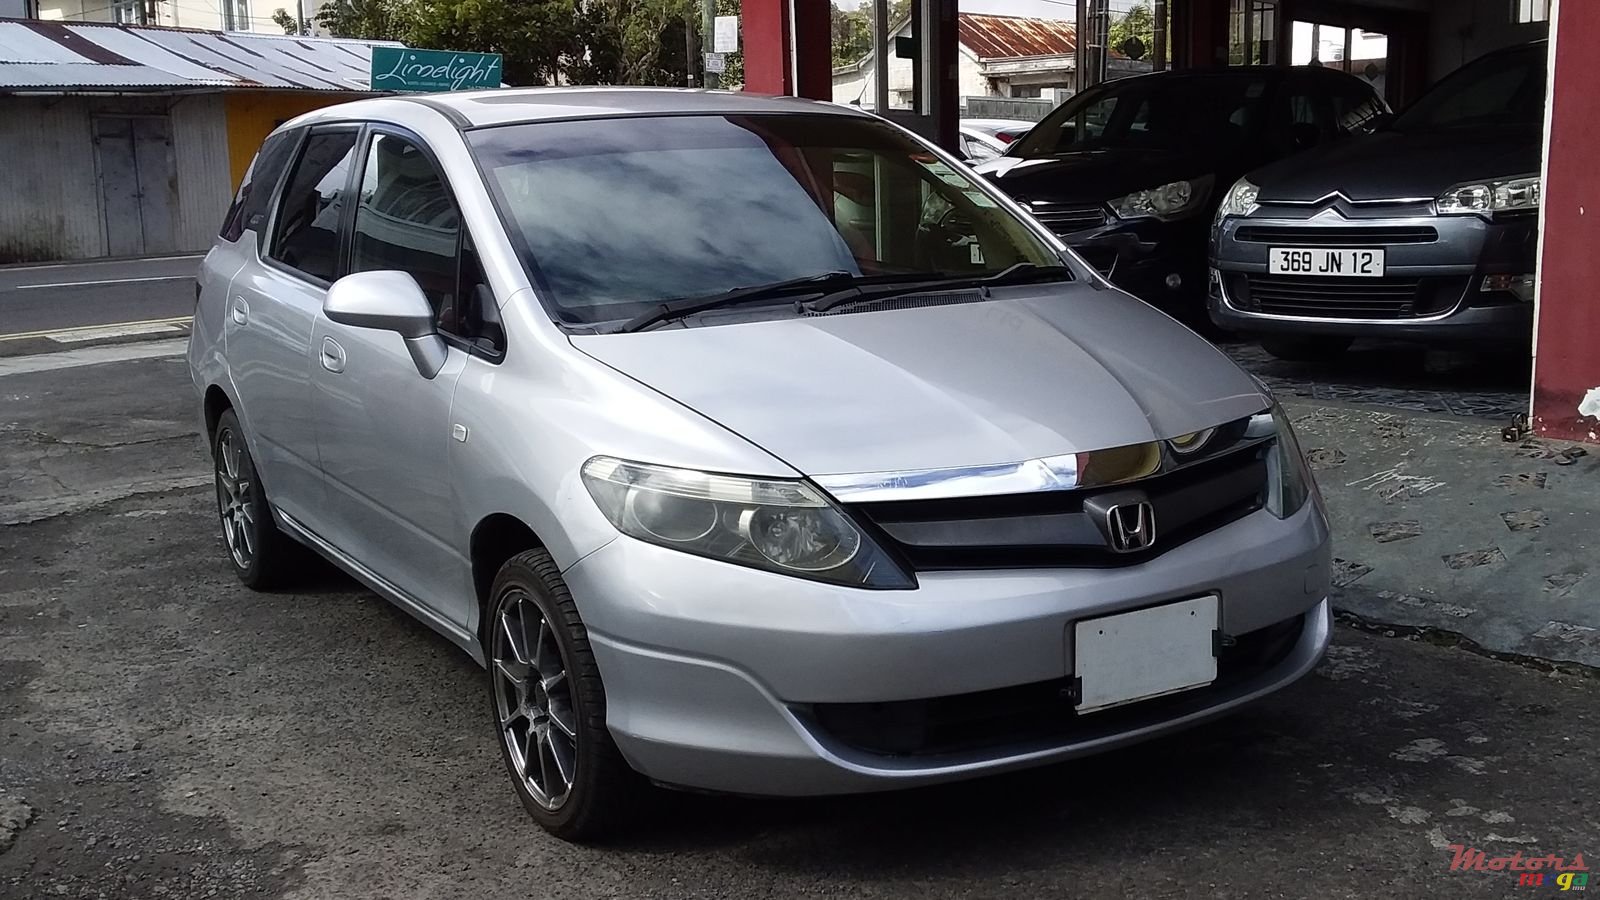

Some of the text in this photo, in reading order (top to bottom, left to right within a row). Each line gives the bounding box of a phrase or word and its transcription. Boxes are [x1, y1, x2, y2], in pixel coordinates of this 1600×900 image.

[375, 51, 499, 91] Limelight
[1280, 251, 1373, 274] 369 JN 12
